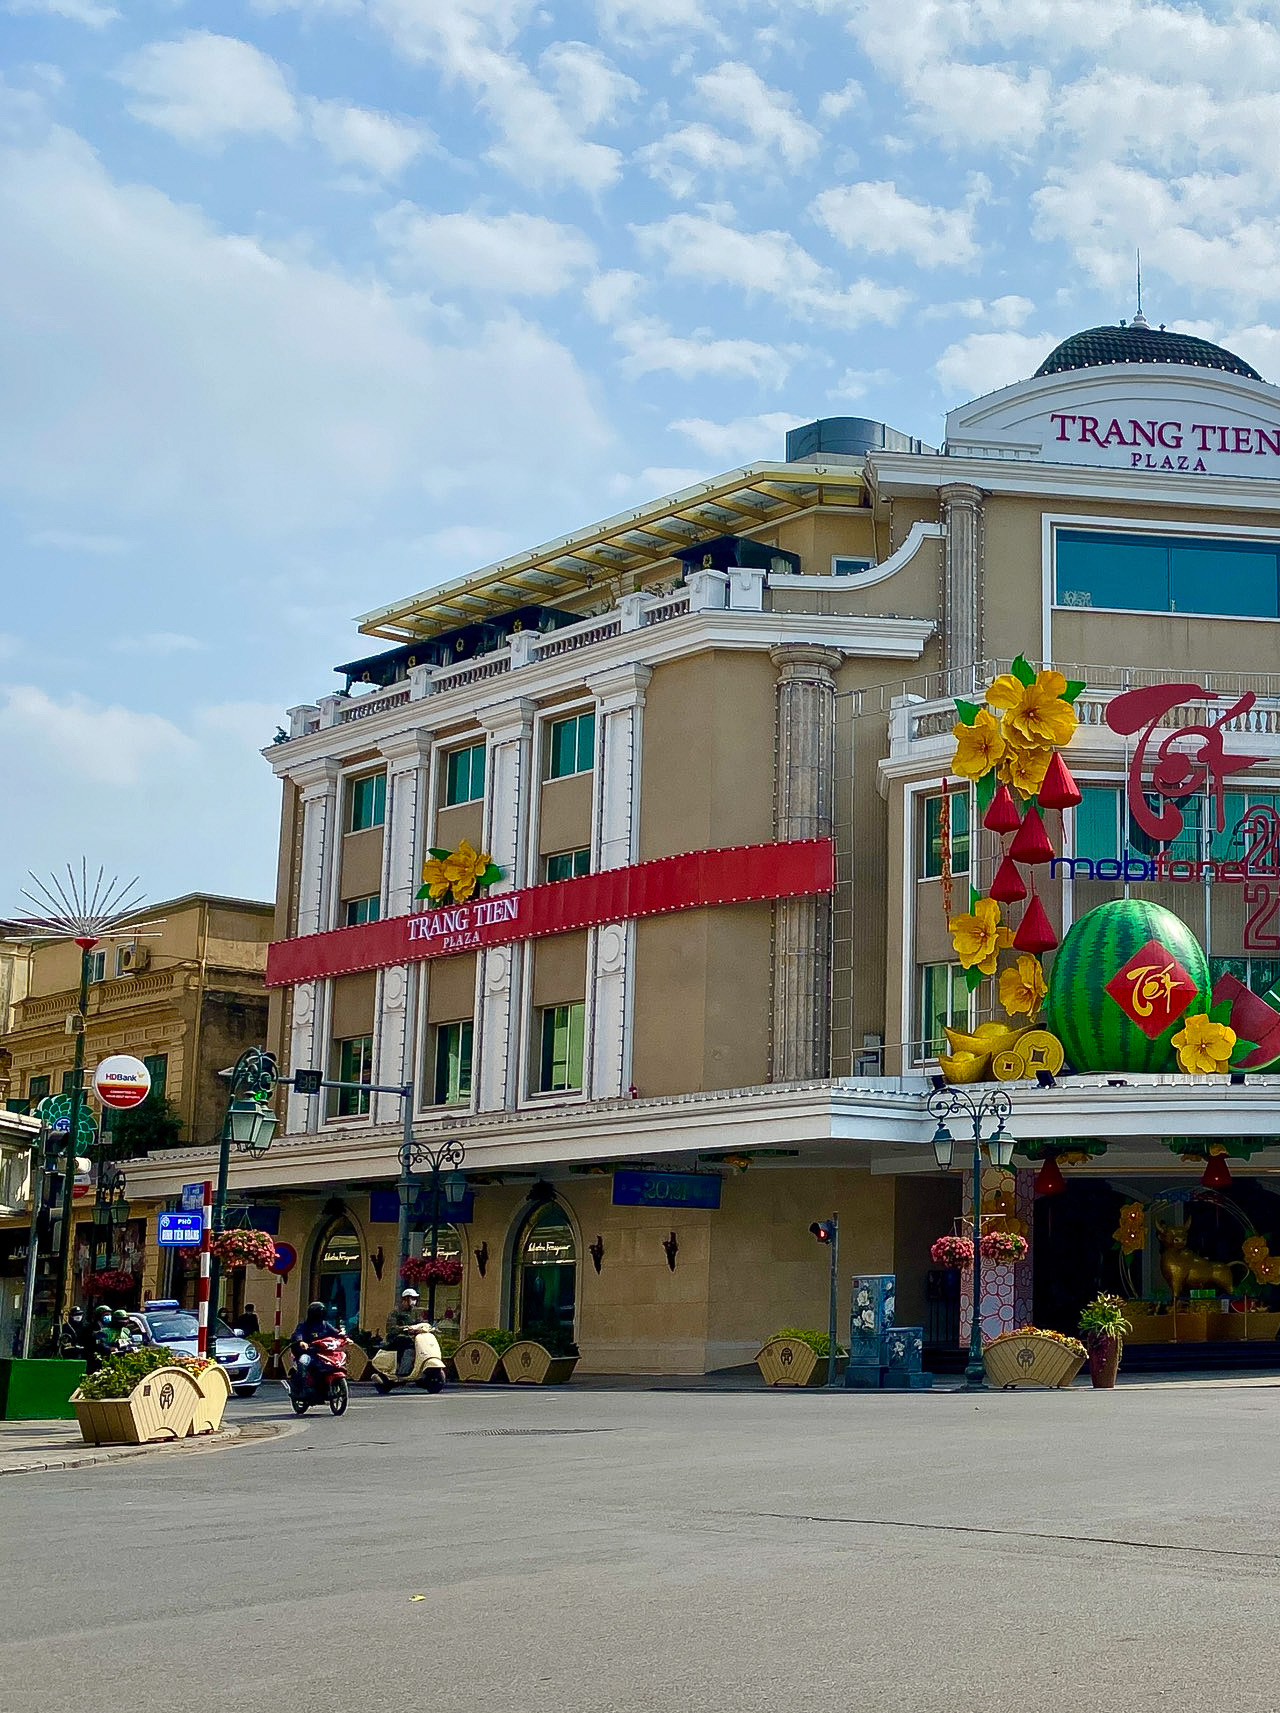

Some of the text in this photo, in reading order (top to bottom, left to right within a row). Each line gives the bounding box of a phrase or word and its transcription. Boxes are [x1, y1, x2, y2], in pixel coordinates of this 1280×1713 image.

[1051, 413, 1183, 449] TRANG
[1131, 452, 1207, 471] PLAZA
[1049, 849, 1248, 884] mobifone
[407, 896, 520, 941] TRANG TIEN
[443, 930, 481, 949] PLAZA
[105, 1073, 137, 1082] HDBank
